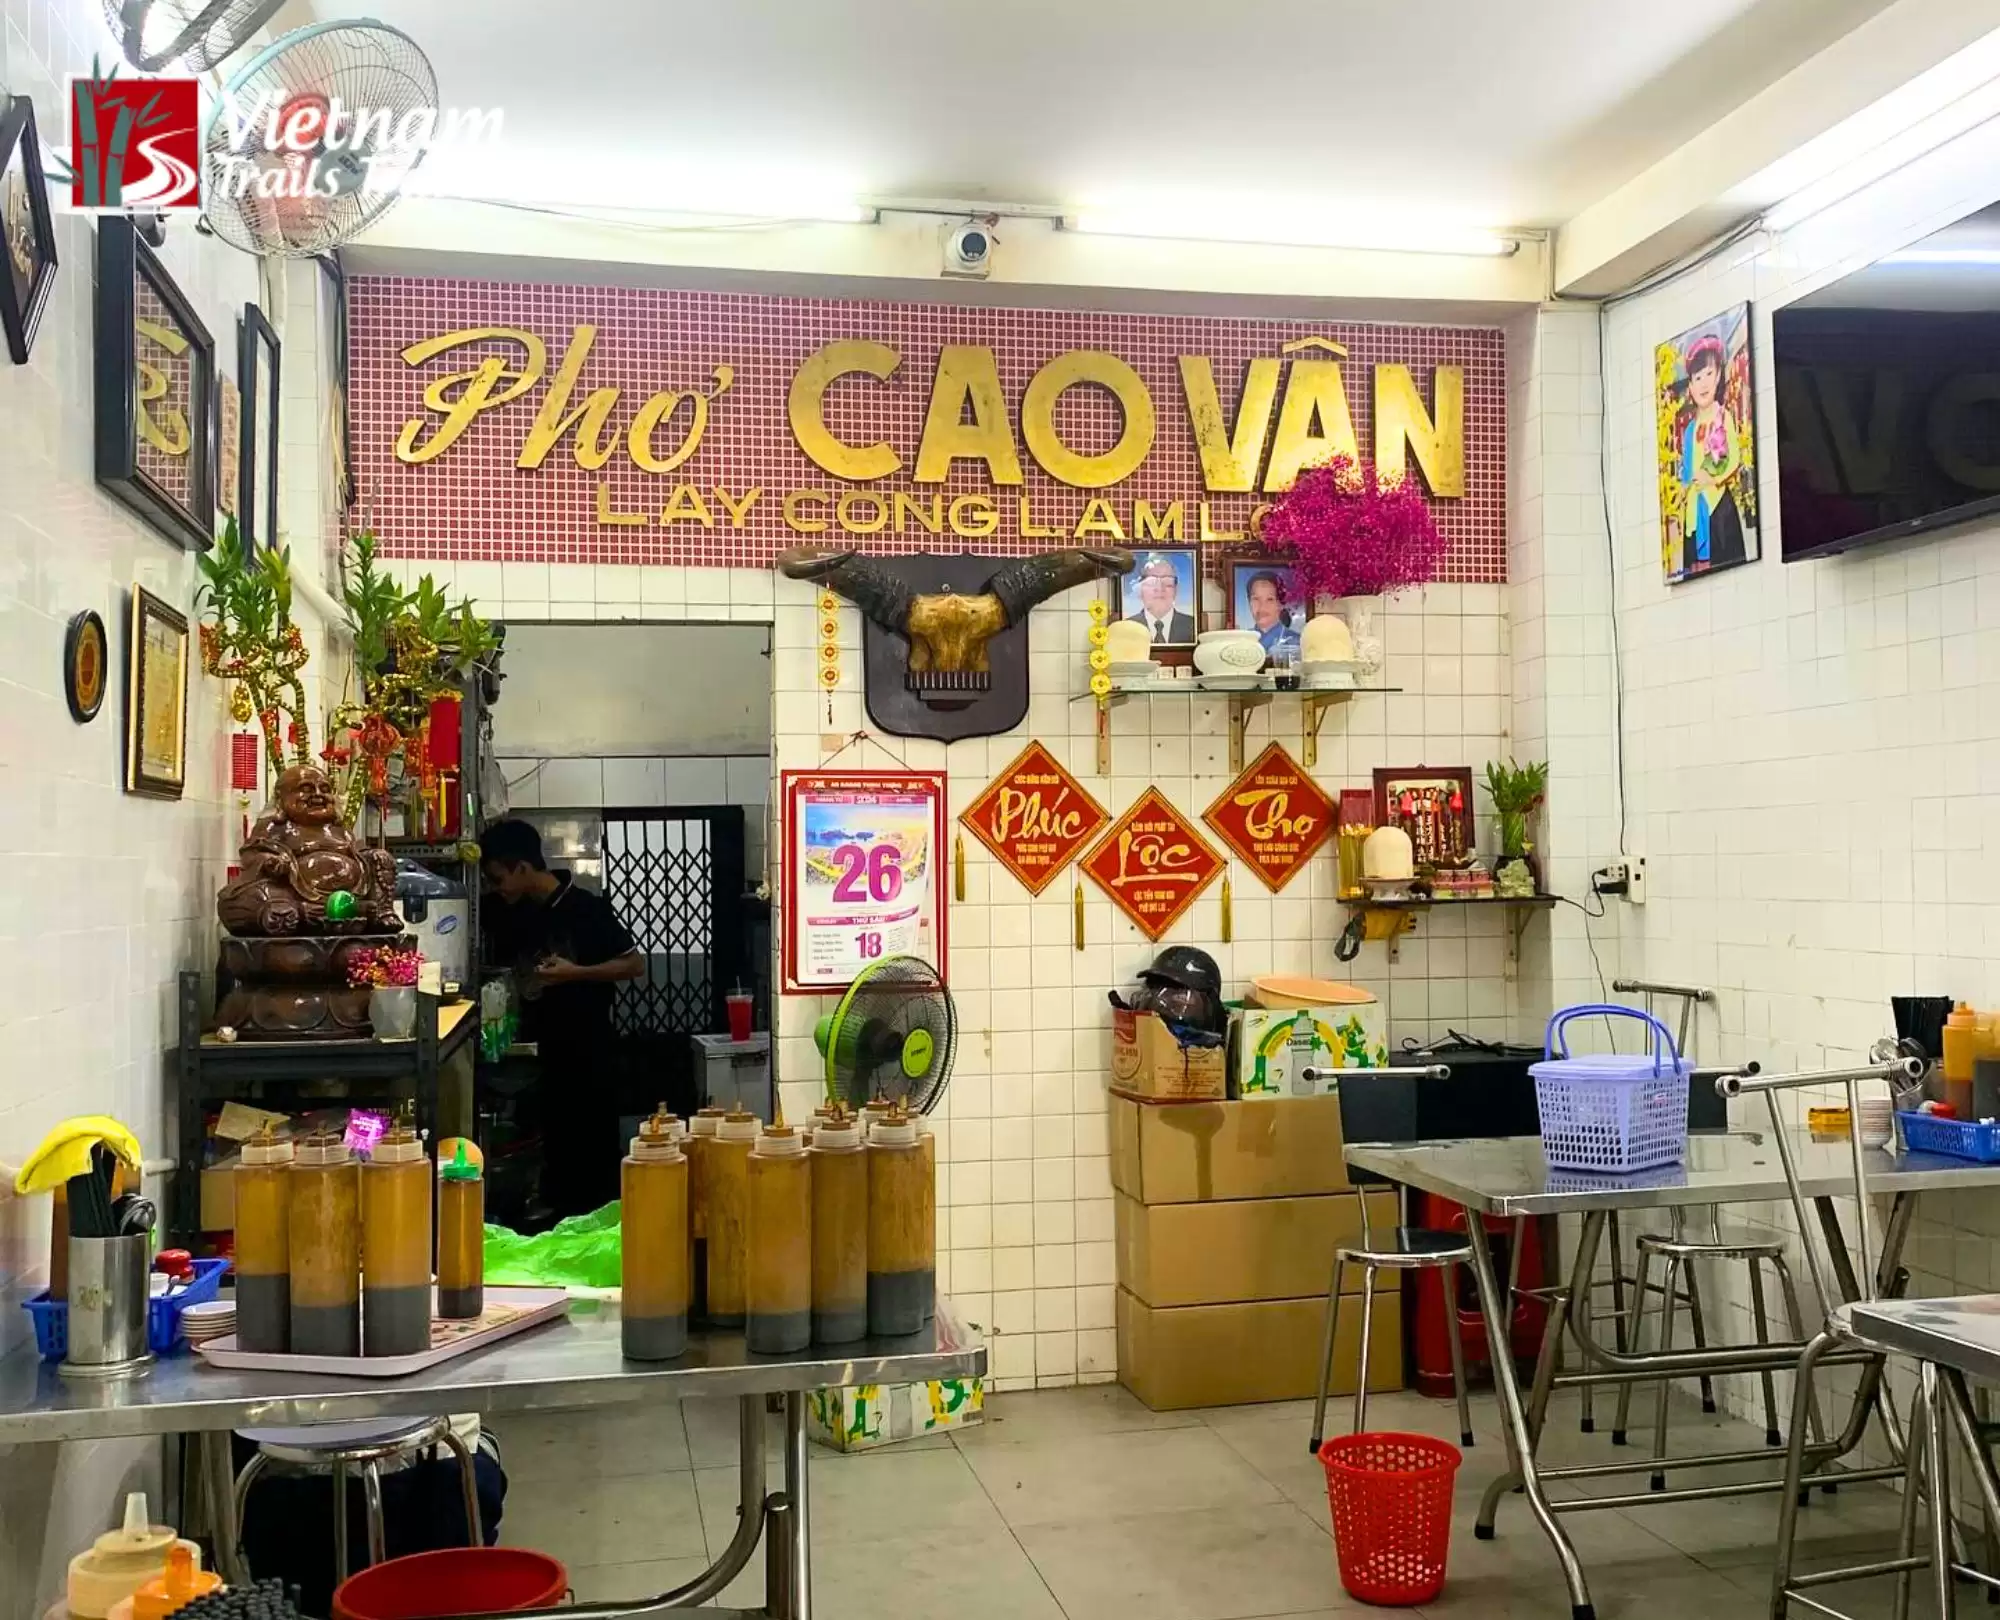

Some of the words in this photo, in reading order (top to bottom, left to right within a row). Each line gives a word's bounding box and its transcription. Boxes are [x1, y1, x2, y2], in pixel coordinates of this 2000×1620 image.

[788, 339, 1156, 489] CAO
[1177, 337, 1466, 498] VÂN
[597, 482, 762, 528] LAY
[782, 489, 1000, 538] CONG
[991, 786, 1088, 844] Phúc
[1234, 789, 1319, 842] Thọ
[832, 844, 904, 903] 26
[1110, 829, 1202, 887] Lộc
[855, 932, 883, 959] 18
